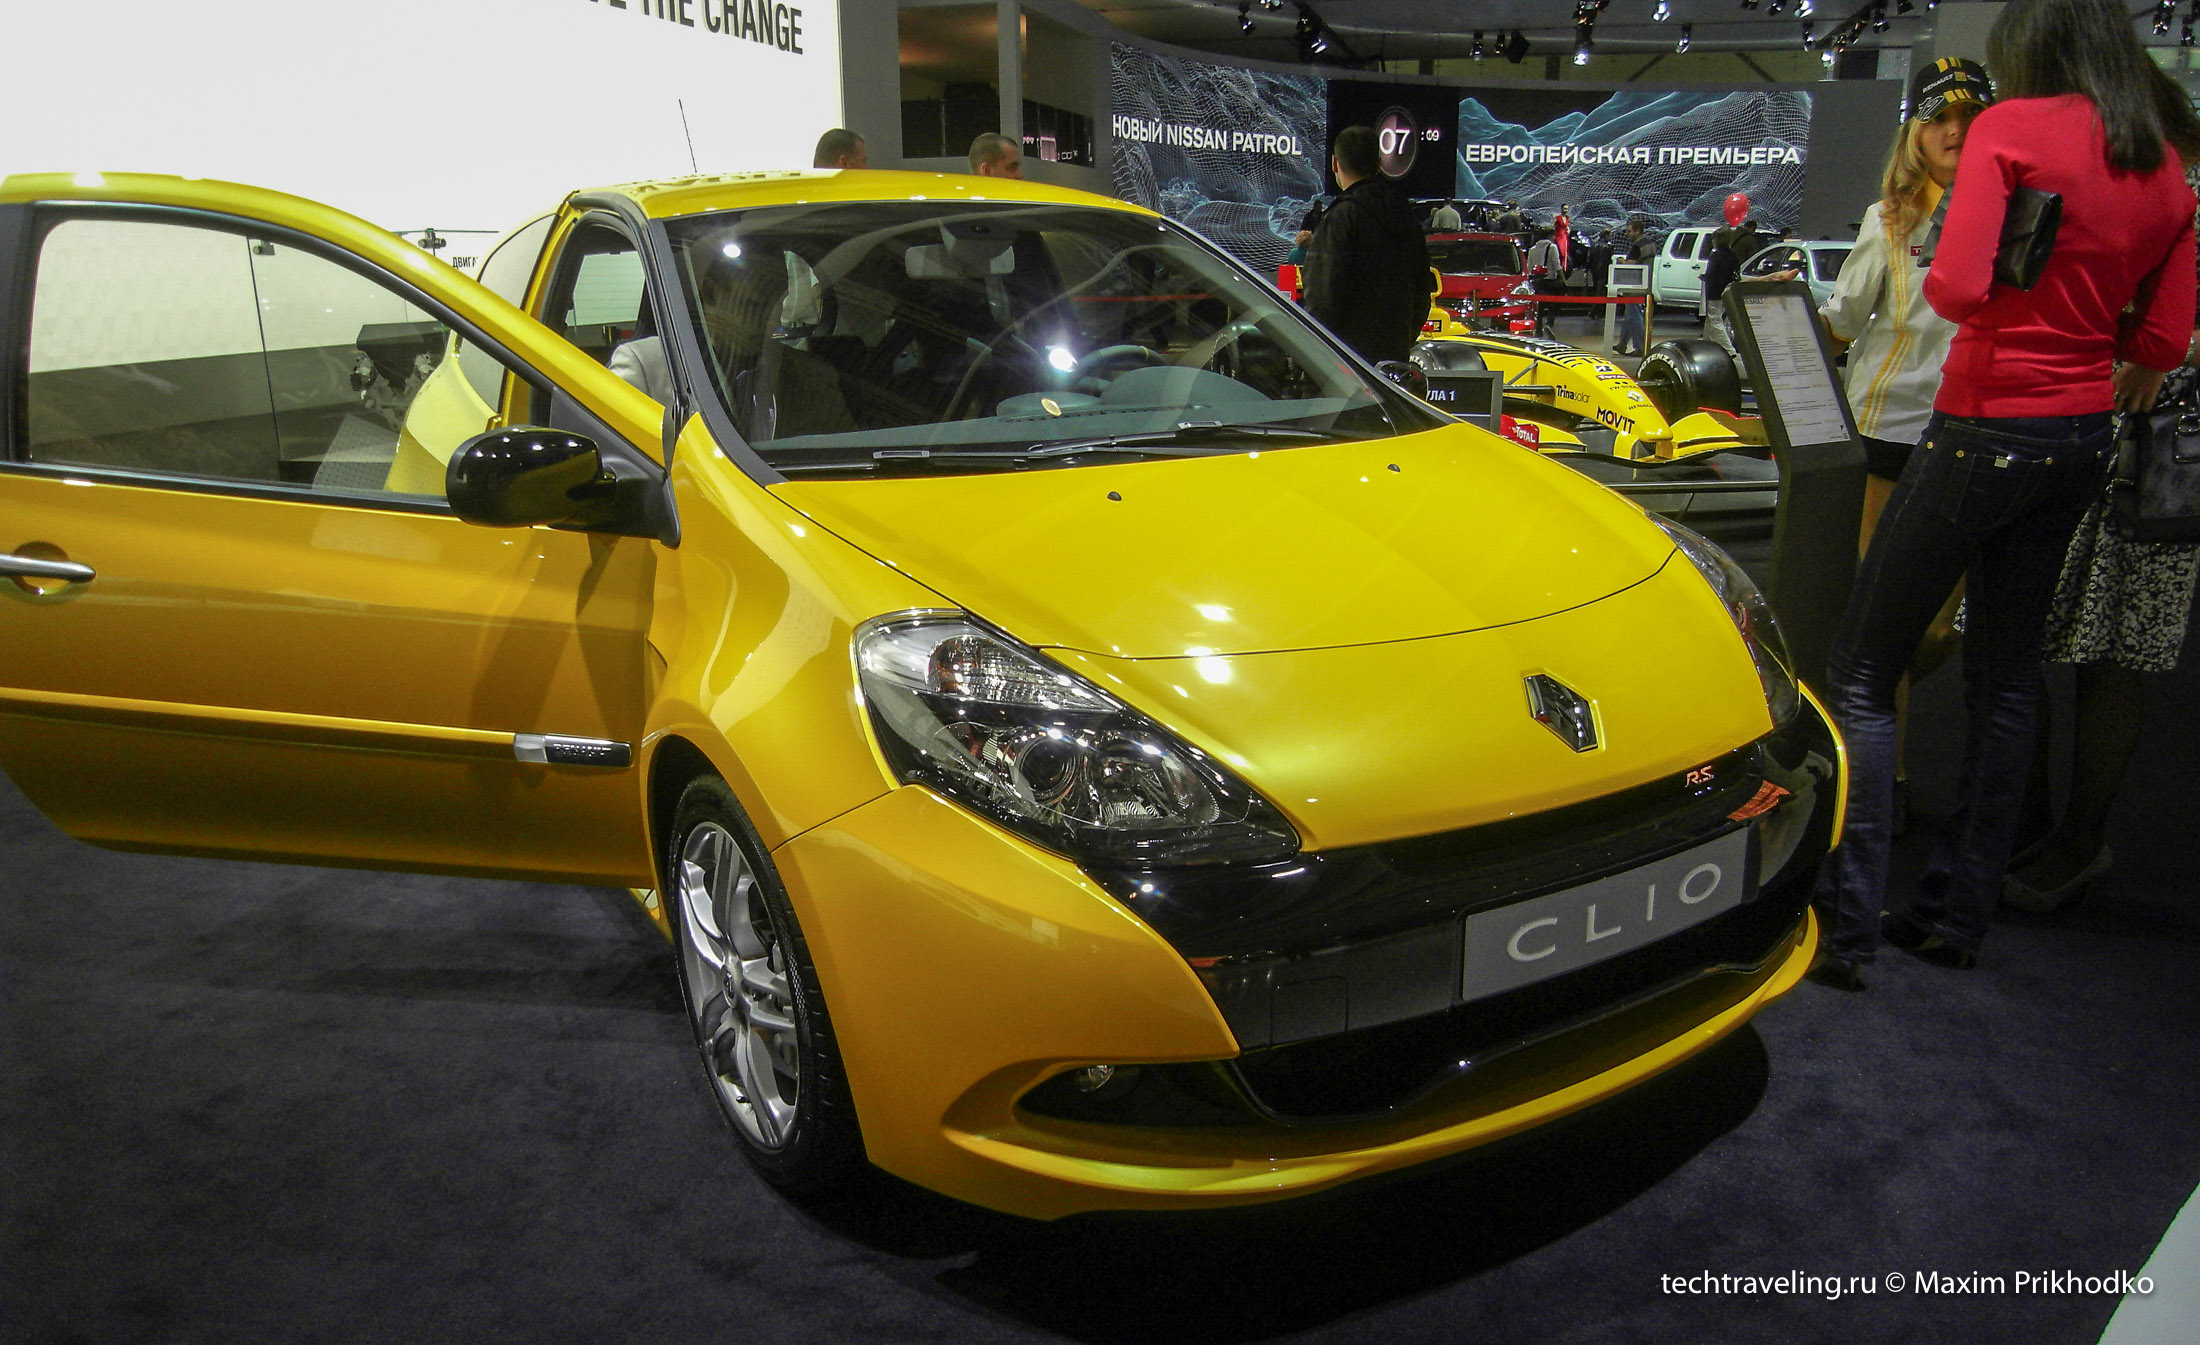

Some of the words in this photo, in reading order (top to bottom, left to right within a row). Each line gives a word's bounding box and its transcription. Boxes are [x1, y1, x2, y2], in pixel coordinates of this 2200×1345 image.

[704, 0, 803, 55] CHANGE
[1112, 113, 1163, 144] НОВЫЙ
[1166, 124, 1227, 151] NISSAN
[1232, 132, 1302, 157] PATROL
[1379, 127, 1411, 155] 07
[1465, 142, 1650, 165] ЕВРОПЕЙСКАЯ
[1658, 147, 1801, 166] ПРЕМЬЕРА
[1449, 390, 1456, 402] 1
[1515, 425, 1536, 444] TOTAL
[1507, 863, 1722, 962] CLIO
